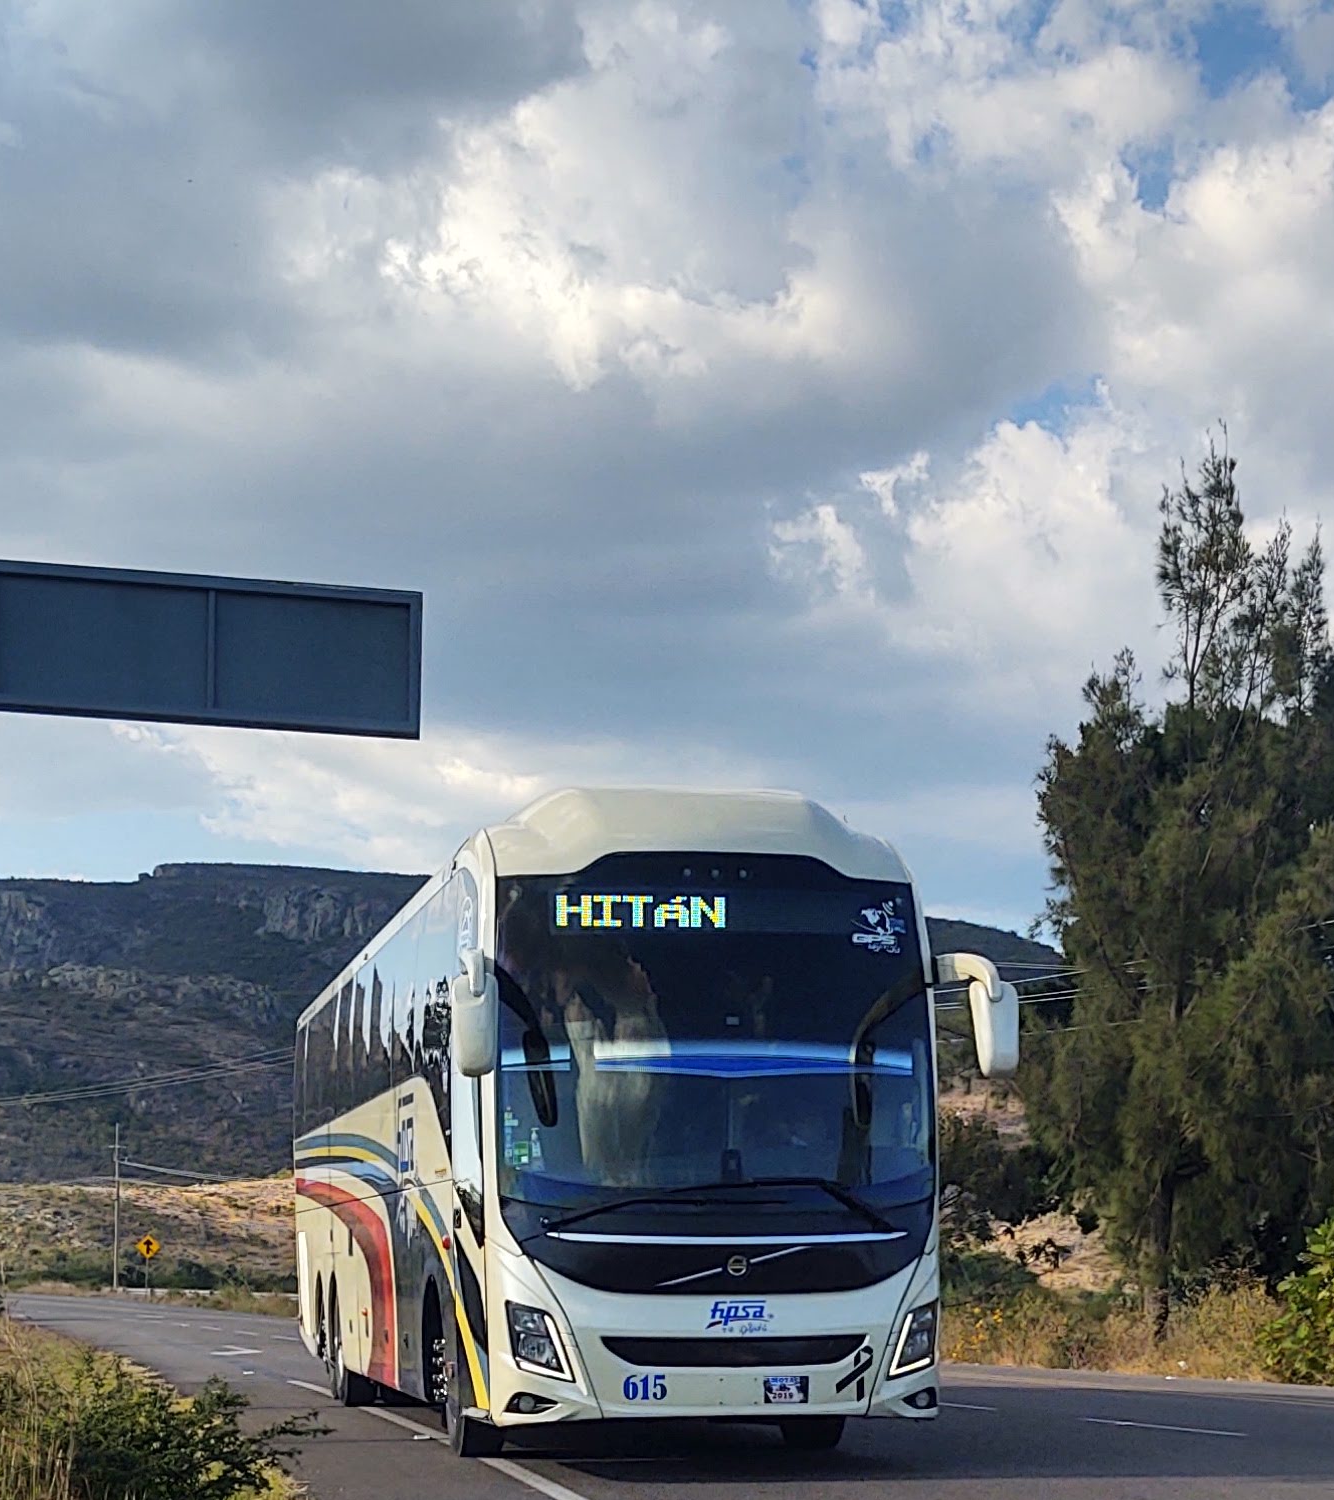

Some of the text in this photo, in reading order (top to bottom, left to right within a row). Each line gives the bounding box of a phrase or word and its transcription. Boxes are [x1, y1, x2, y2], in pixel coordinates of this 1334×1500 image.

[556, 895, 725, 928] HITÁN
[852, 933, 896, 944] GPS
[623, 1374, 667, 1400] 615
